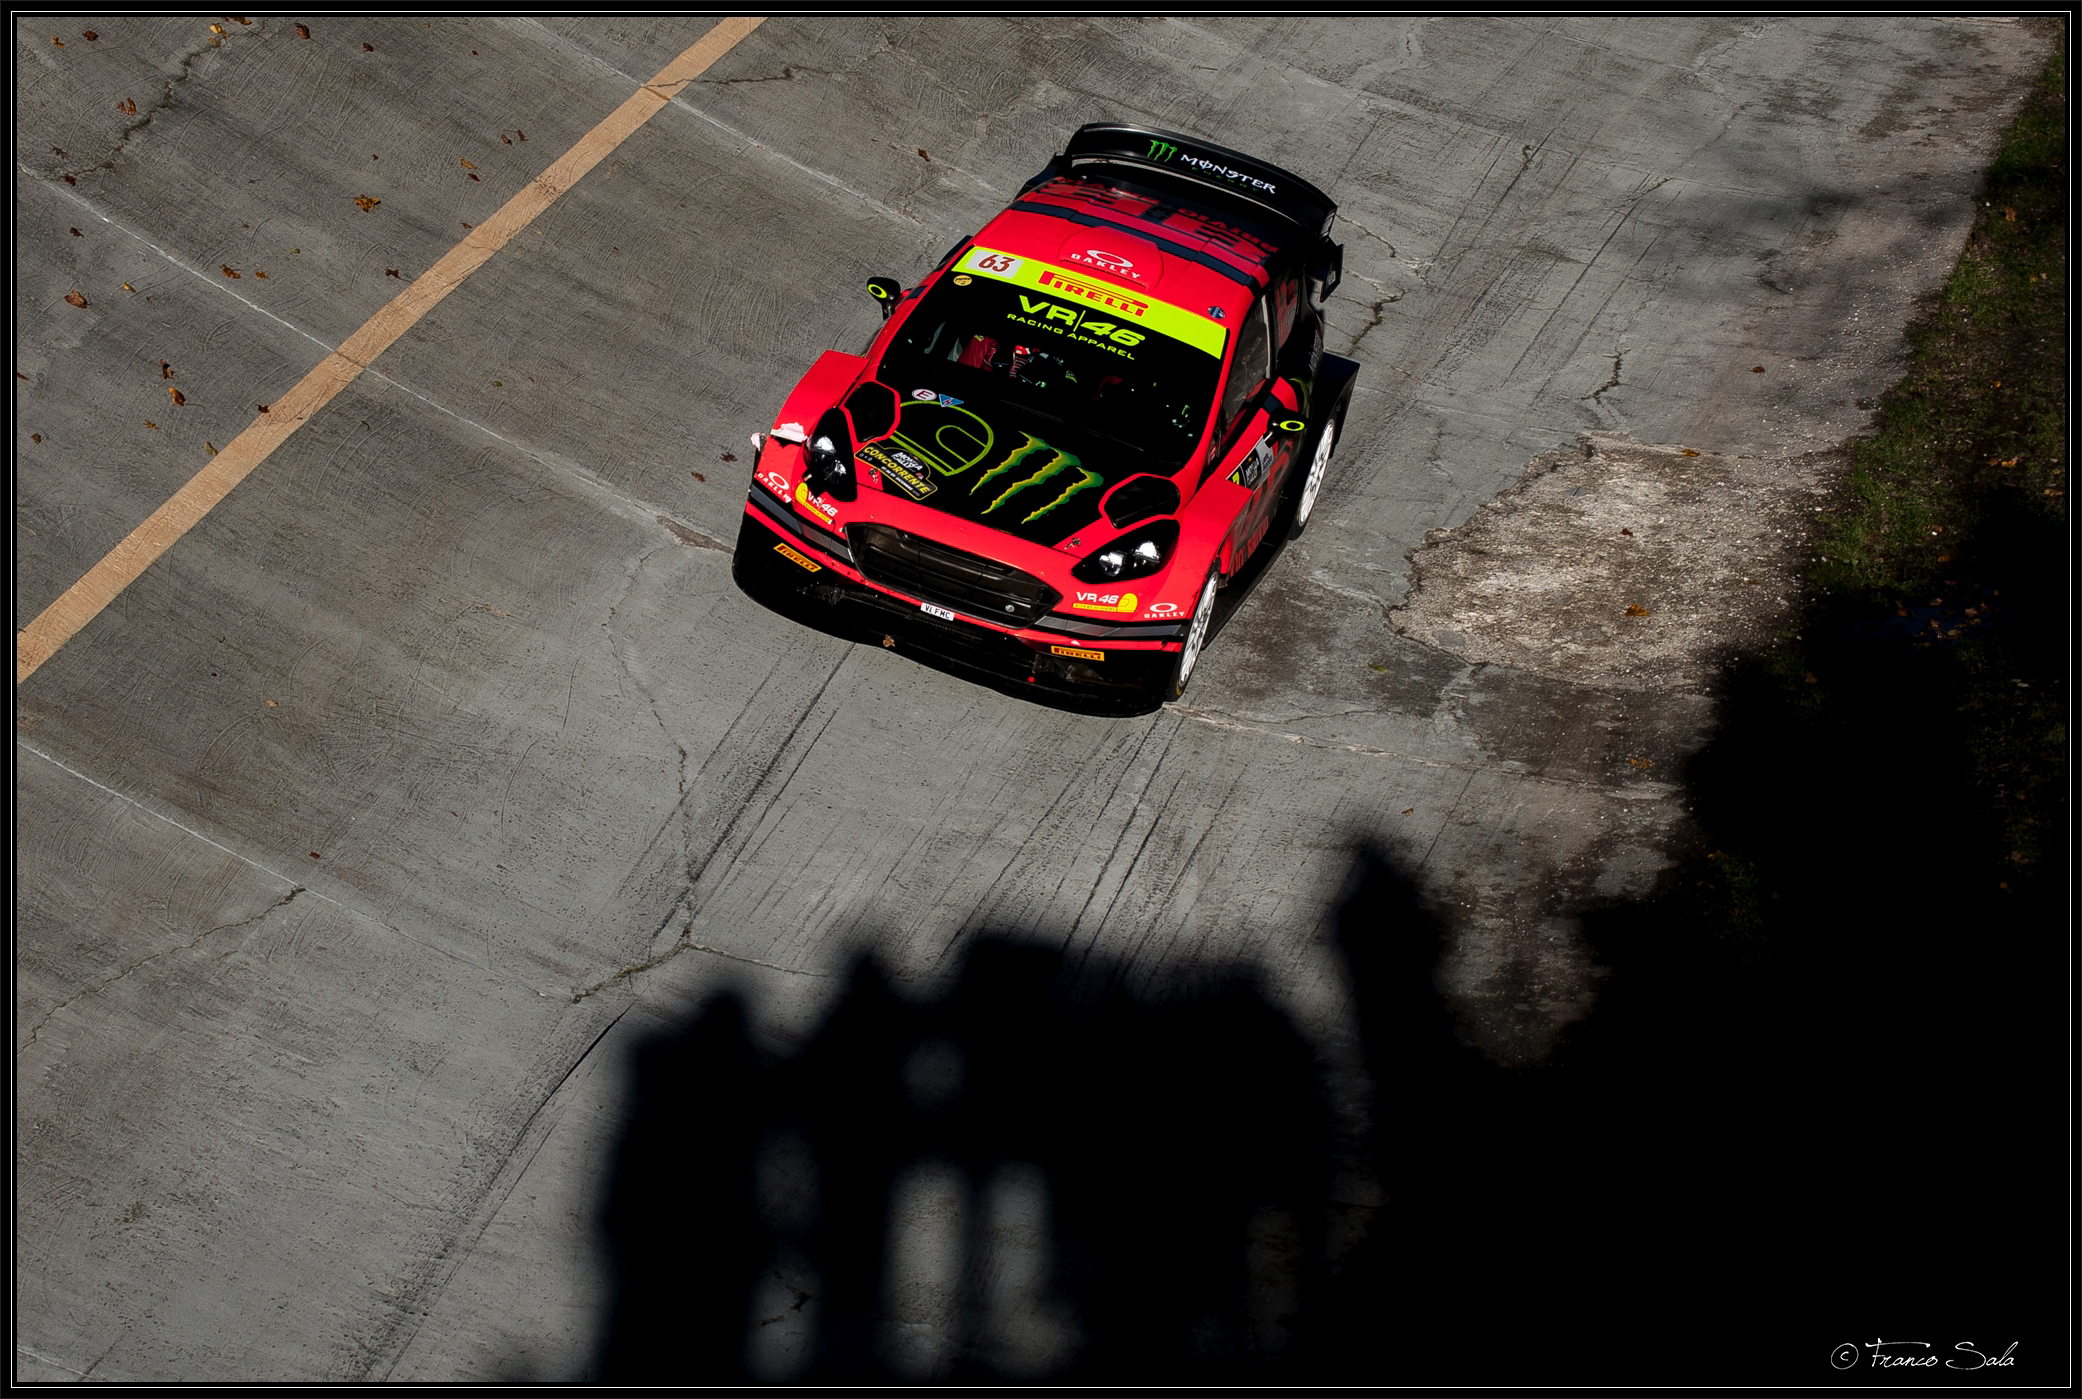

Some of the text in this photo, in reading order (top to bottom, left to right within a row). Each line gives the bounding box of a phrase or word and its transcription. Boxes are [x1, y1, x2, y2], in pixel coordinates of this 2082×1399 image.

[1180, 153, 1276, 194] MONSTER
[978, 254, 1015, 273] 63
[1071, 253, 1142, 279] OAKLEY
[1038, 270, 1149, 317] PIRELLI
[1007, 313, 1135, 360] RACING APPAREL
[864, 446, 931, 494] CONCORRENTE
[777, 545, 820, 571] PIRELLI
[934, 608, 951, 619] FMC
[1144, 611, 1184, 619] OAKLEY
[1053, 647, 1102, 660] PIRELLI
